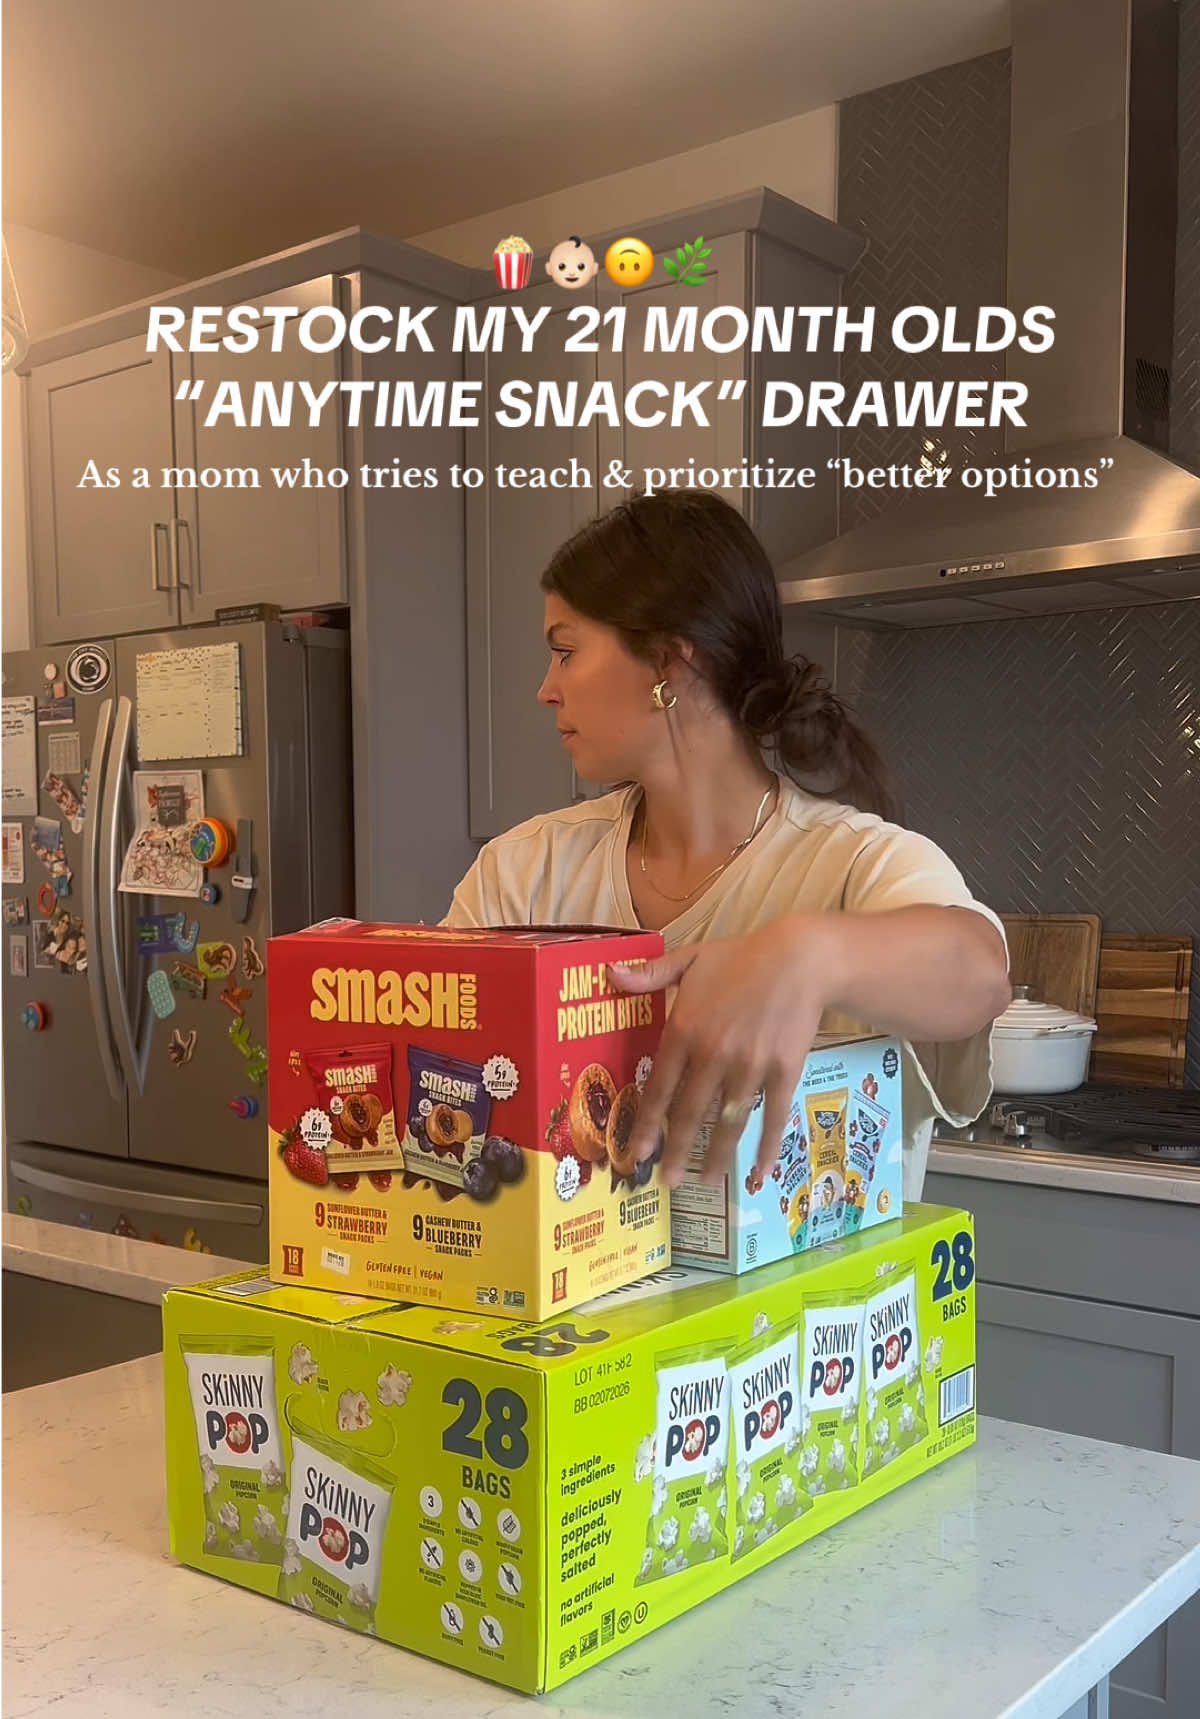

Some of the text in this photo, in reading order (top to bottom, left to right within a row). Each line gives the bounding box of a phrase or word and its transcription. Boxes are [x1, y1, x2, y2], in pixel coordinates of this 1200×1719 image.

[560, 959, 646, 1003] JAM-P
[459, 973, 476, 1030] FOODS
[558, 995, 652, 1042] PROTEIN BITES
[315, 1202, 325, 1227] 9
[328, 1203, 360, 1215] SUNFLOWER
[361, 1207, 381, 1218] BUTTER
[327, 1215, 387, 1235] STRAWBERRY
[413, 1214, 481, 1240] 9 CASHEW BUTTER &
[620, 1201, 626, 1226] 9
[627, 1200, 659, 1224] BLUEBERRY
[425, 1228, 481, 1248] BLUEBERRY
[554, 1224, 561, 1251] 9
[562, 1221, 604, 1248] STRAWBERRY
[288, 1248, 299, 1265] 18
[367, 1261, 392, 1273] GLUTEN
[420, 1269, 443, 1280] VEGAN
[931, 1231, 975, 1303] 28
[943, 1296, 966, 1322] BAGS
[501, 1323, 610, 1357] 28
[872, 1327, 912, 1380] POP
[574, 1367, 592, 1386] LOT
[810, 1356, 854, 1398] POP
[574, 1381, 630, 1414] BB 02072026
[206, 1411, 269, 1454] POP
[442, 1377, 530, 1470] 28
[744, 1391, 792, 1452] POP
[665, 1415, 720, 1467] POP
[462, 1465, 512, 1500] BAGS
[561, 1455, 601, 1480] 3 simple
[561, 1464, 615, 1496] ingredients
[230, 1480, 260, 1492] ORIGINAL
[428, 1495, 434, 1507] 3
[562, 1488, 622, 1527] deliciously
[300, 1502, 369, 1570] POP
[561, 1513, 607, 1549] popped,
[561, 1529, 612, 1568] perfectly
[561, 1553, 596, 1582] salted
[312, 1577, 343, 1603] ORIGINAL
[561, 1573, 614, 1611] no artificial
[561, 1601, 592, 1627] flavors
